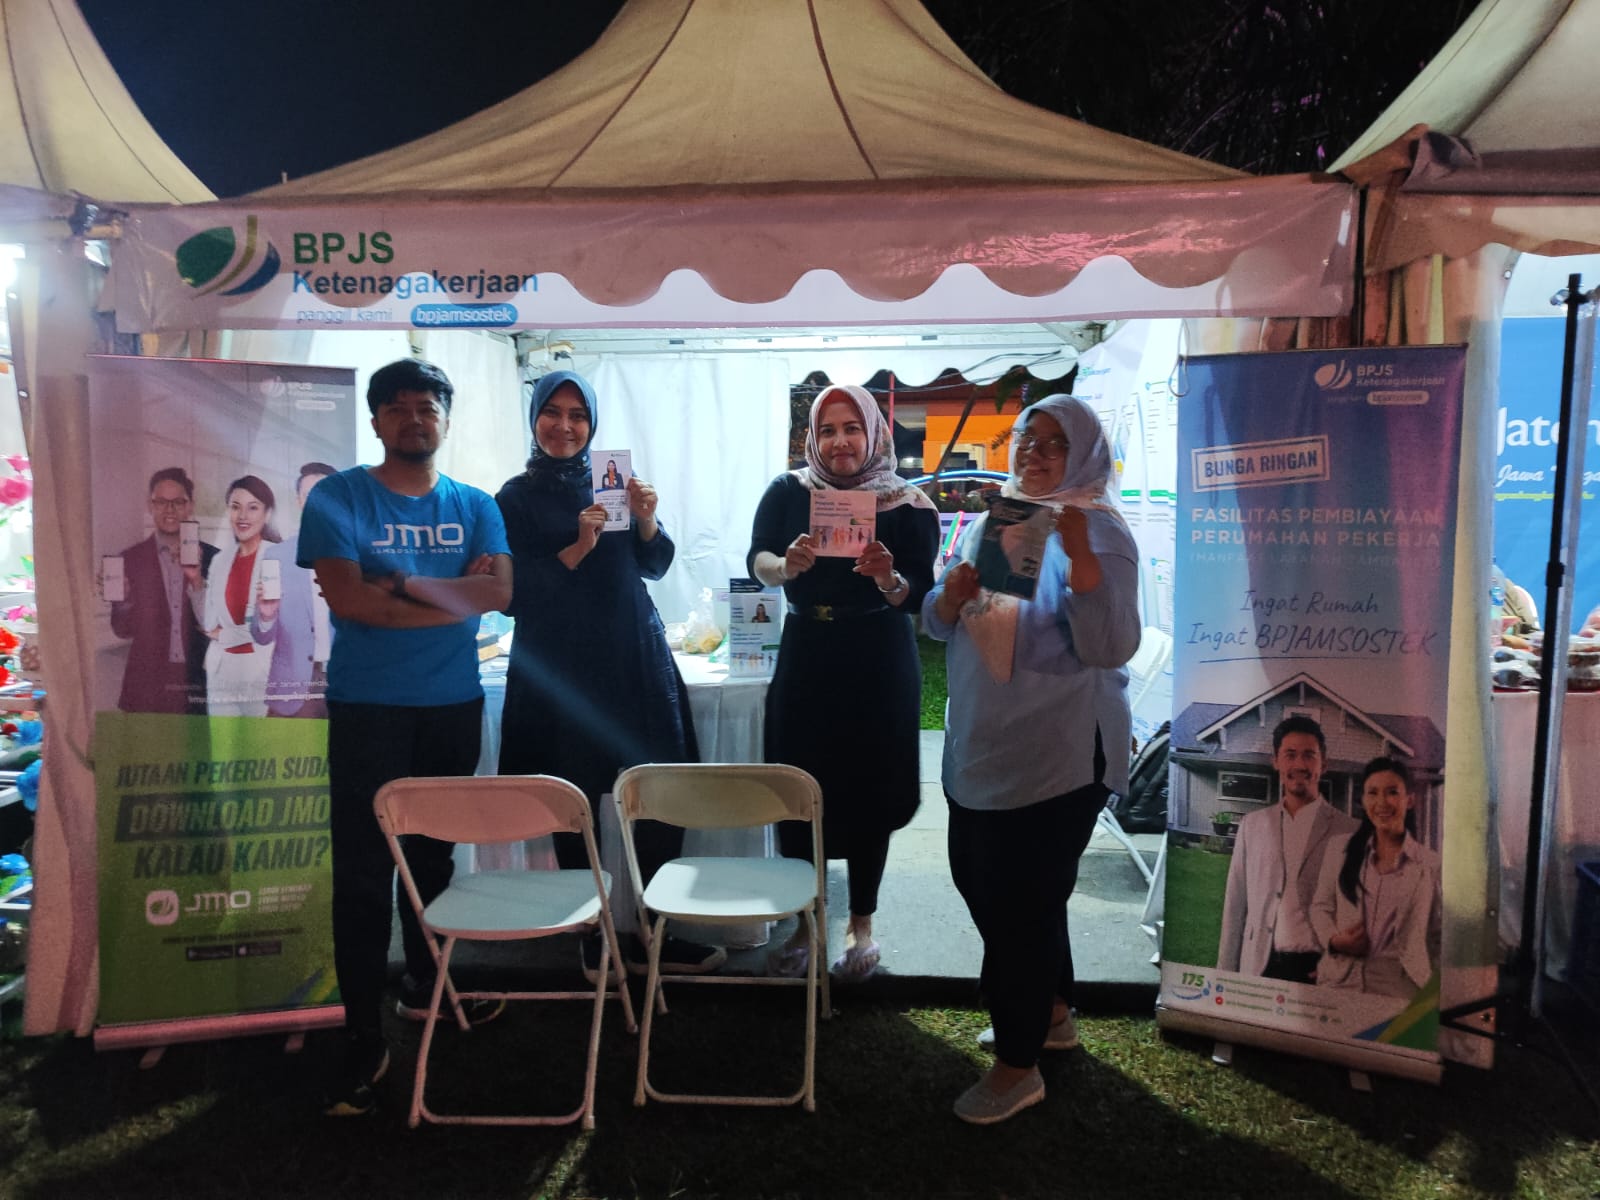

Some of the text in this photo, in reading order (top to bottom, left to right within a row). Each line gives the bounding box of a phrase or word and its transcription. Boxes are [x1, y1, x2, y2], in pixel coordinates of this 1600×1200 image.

[293, 231, 395, 264] BPJS
[292, 269, 538, 299] Ketenagakerjaan
[296, 307, 513, 325] panggil kami bpjamsostek
[1356, 364, 1394, 377] BPJS
[1204, 450, 1318, 478] BUNGA RINGAN
[1191, 507, 1293, 525] FASILITAS
[1300, 508, 1440, 525] PEMBIAYAAN
[371, 522, 465, 547] JMO
[1191, 529, 1441, 547] PERUMAHAN PEKERJA
[1239, 589, 1379, 616] Ingat Rumah
[1186, 622, 1438, 656] Ingat BPJAMSOSTEK
[194, 758, 277, 785] PEKERJA
[129, 794, 331, 834] DOWNLOAD JMO
[134, 836, 330, 879] KALAU KAMU?
[184, 890, 251, 912] JMO
[1181, 972, 1206, 987] 175
